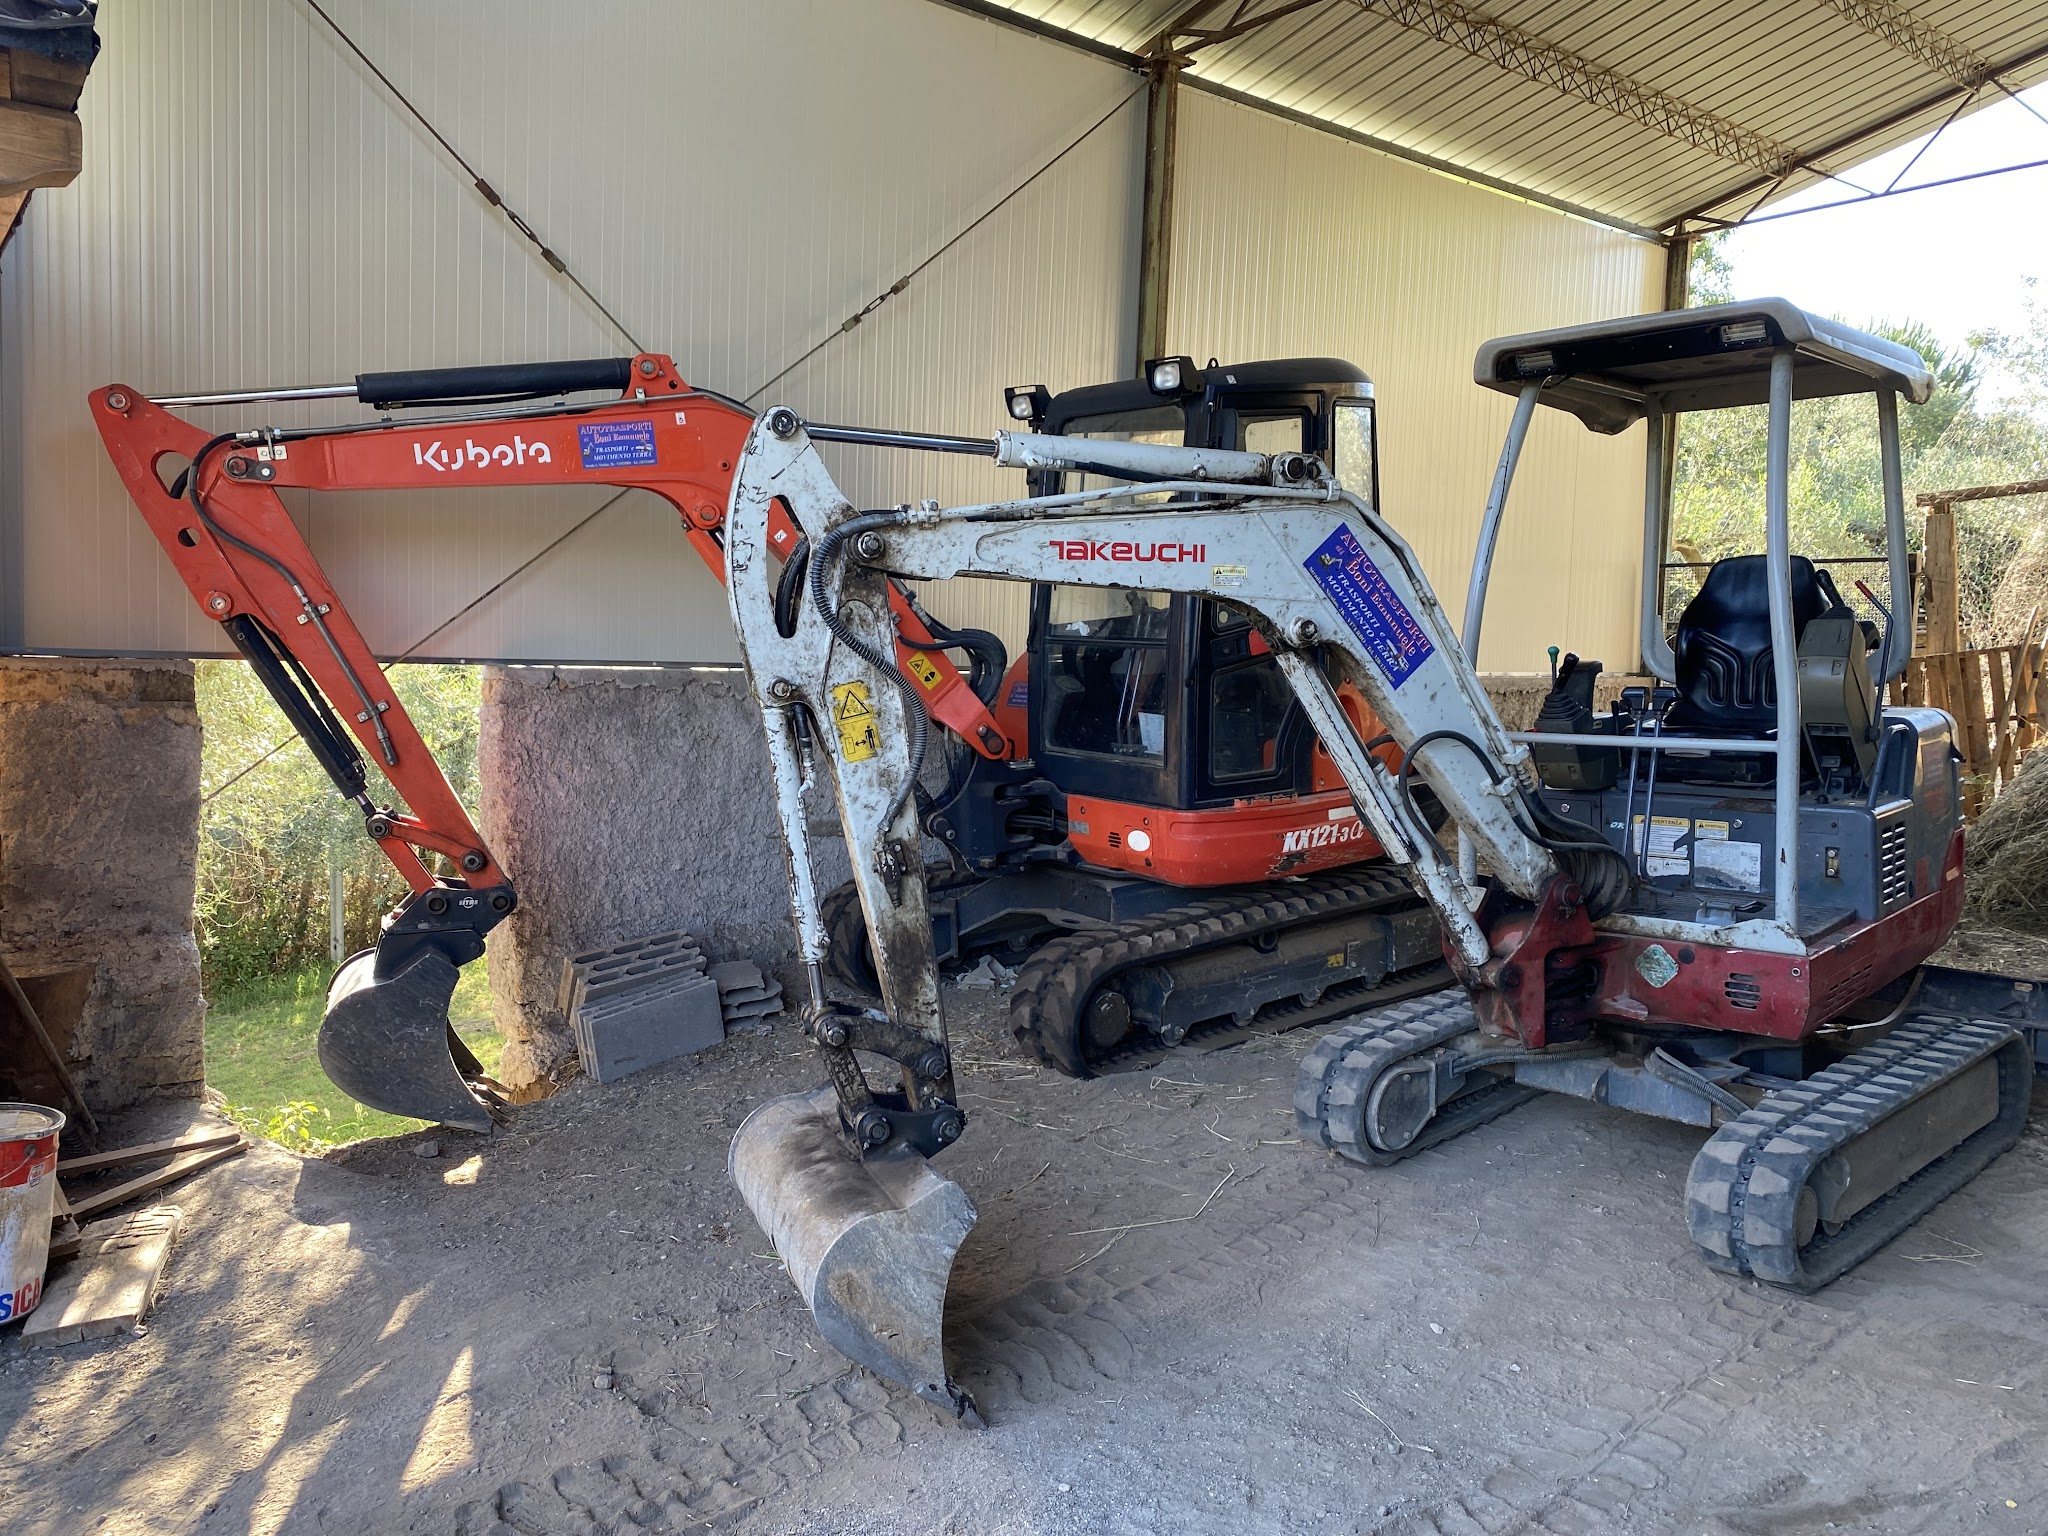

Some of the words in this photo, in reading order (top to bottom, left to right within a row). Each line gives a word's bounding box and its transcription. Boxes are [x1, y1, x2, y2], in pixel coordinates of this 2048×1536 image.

[581, 422, 652, 434] AUTOTRASPORTI
[413, 436, 551, 472] Kubota
[593, 453, 631, 461] MOVIMENTO
[1049, 541, 1206, 562] TAKEUCHI
[1337, 573, 1380, 628] TRASPORTI
[1340, 533, 1431, 653] AUTOTRASPORTI
[1345, 560, 1373, 593] Boni
[1371, 593, 1416, 656] Emanuele
[1326, 575, 1375, 639] MOVIMENTO
[1374, 639, 1399, 671] TERRA
